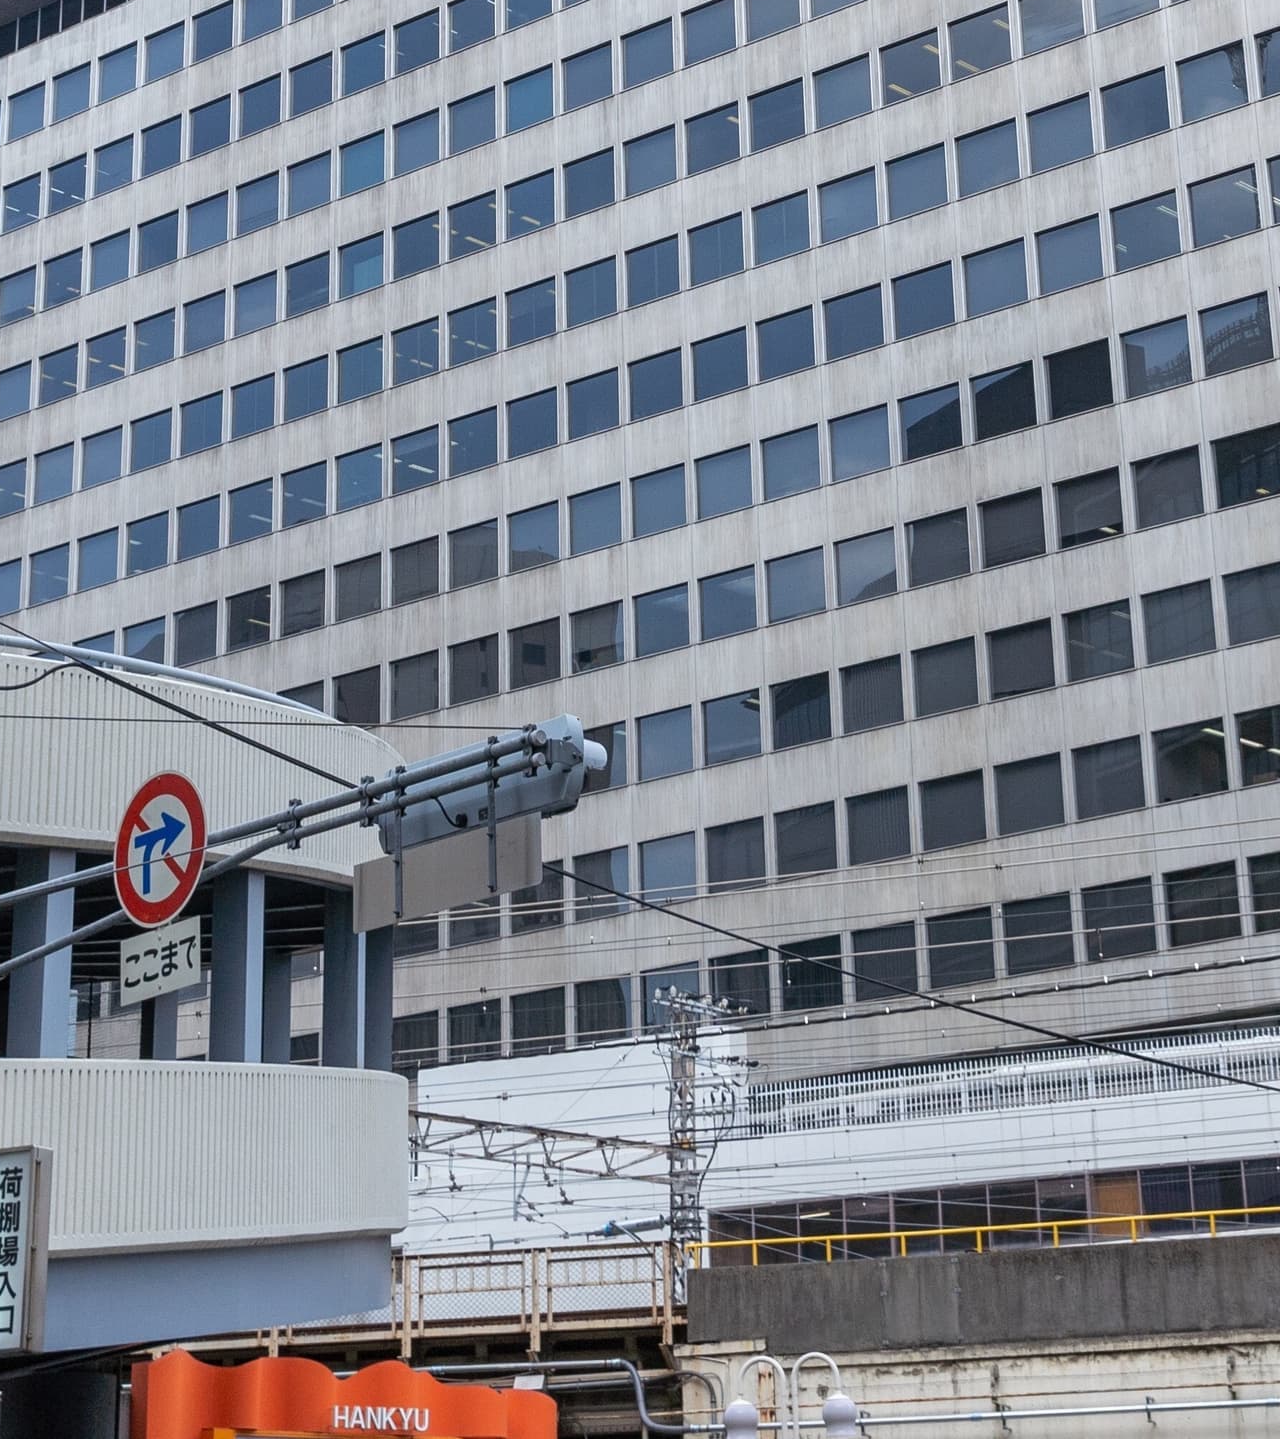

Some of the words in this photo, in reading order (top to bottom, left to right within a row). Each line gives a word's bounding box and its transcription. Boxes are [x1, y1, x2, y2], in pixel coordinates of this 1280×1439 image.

[124, 935, 196, 988] ここまで
[333, 1405, 430, 1432] HANKYU
